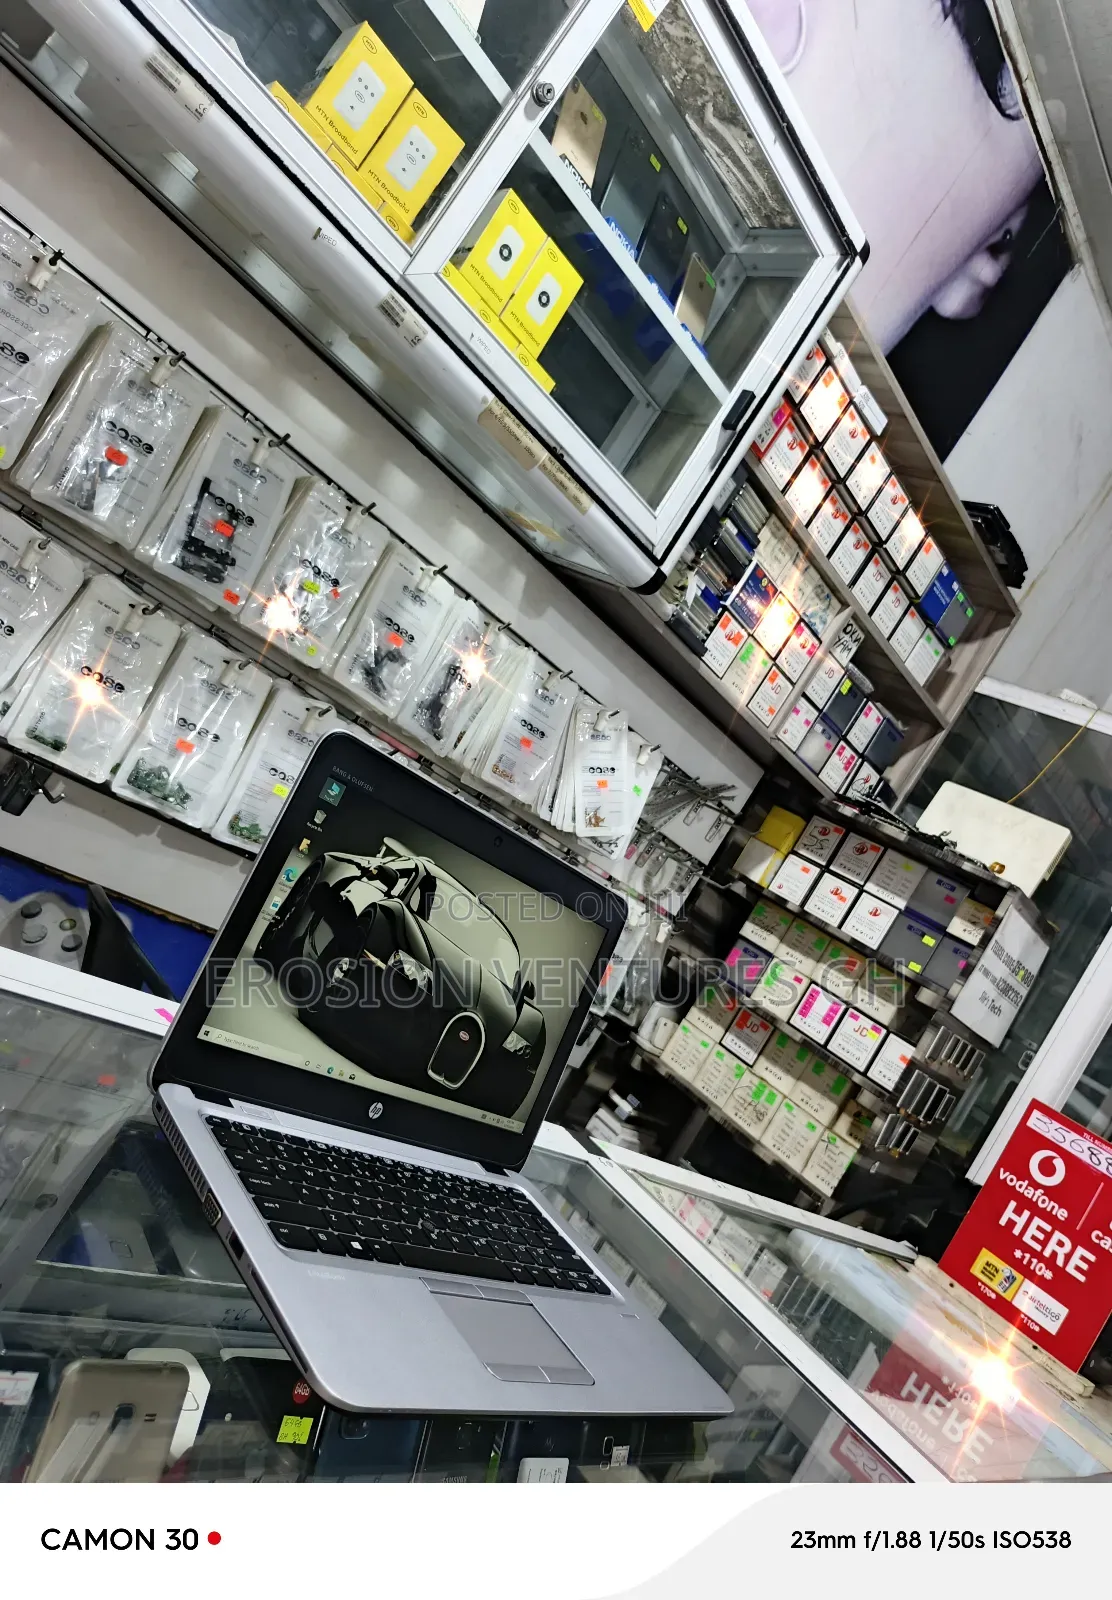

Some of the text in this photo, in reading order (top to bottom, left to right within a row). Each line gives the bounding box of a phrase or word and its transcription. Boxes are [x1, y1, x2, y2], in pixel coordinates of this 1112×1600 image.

[316, 105, 359, 155] MTN Broadband
[368, 169, 410, 214] MTN Broadband
[563, 158, 592, 201] NOKIA
[609, 221, 638, 259] NOKIA
[469, 263, 504, 303] MTN Broadband
[509, 310, 541, 347] MTN Broadband
[104, 420, 154, 455] case
[213, 496, 256, 526] case
[300, 559, 341, 588] case
[383, 617, 417, 643] case
[80, 665, 126, 694] case
[770, 683, 782, 695] JD
[520, 719, 546, 739] case
[332, 766, 347, 778] BANG
[352, 777, 374, 792] OLUFSEN
[588, 766, 616, 775] case
[988, 998, 1002, 1017] Tech
[369, 1102, 384, 1119] hp
[1082, 1132, 1094, 1141] TILL
[999, 1167, 1069, 1222] vodafone
[999, 1200, 1096, 1283] HERE
[1091, 1230, 1112, 1254] ca
[985, 1259, 1000, 1274] MTN
